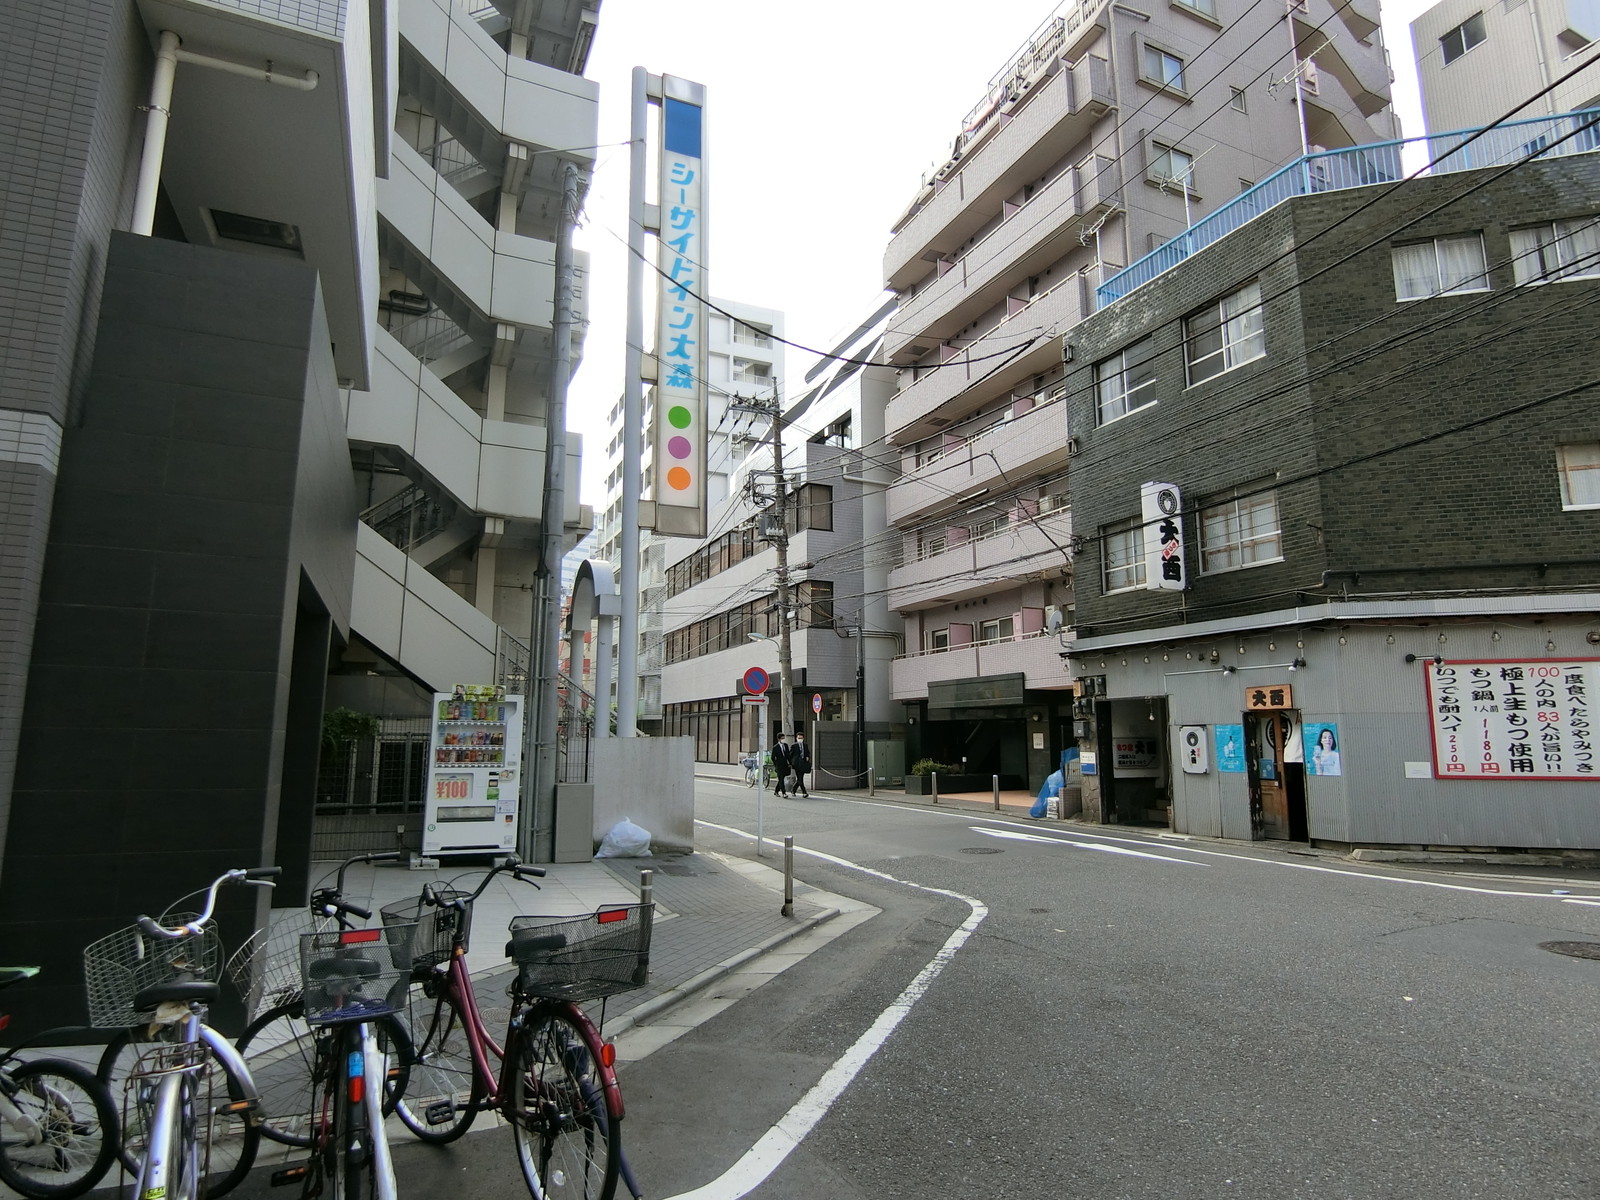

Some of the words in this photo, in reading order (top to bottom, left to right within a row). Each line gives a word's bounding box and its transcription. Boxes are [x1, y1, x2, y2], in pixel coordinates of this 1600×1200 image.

[666, 162, 696, 390] シーサイドイン大森
[1499, 666, 1534, 773] 極上生もつ使用
[1562, 665, 1594, 773] 一度食べたらやみつき
[436, 781, 468, 798] ¥100
